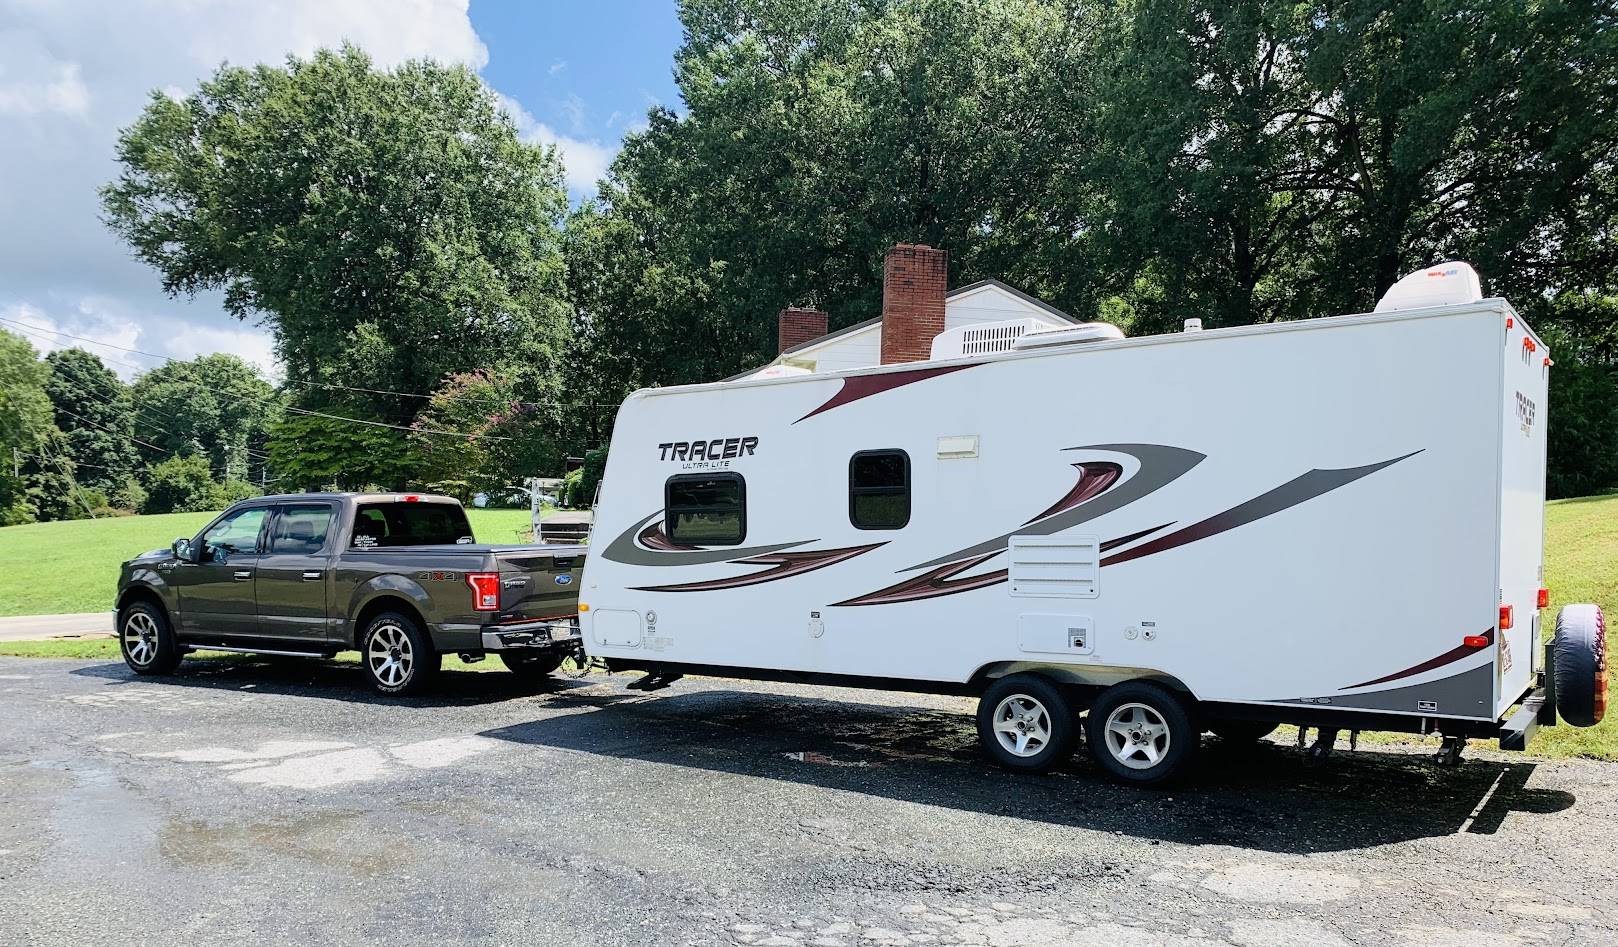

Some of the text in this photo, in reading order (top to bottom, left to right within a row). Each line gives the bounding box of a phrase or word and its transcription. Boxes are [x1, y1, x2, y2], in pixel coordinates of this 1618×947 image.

[658, 436, 759, 462] TRACER
[682, 461, 709, 470] ULTRA
[711, 460, 730, 468] LITE
